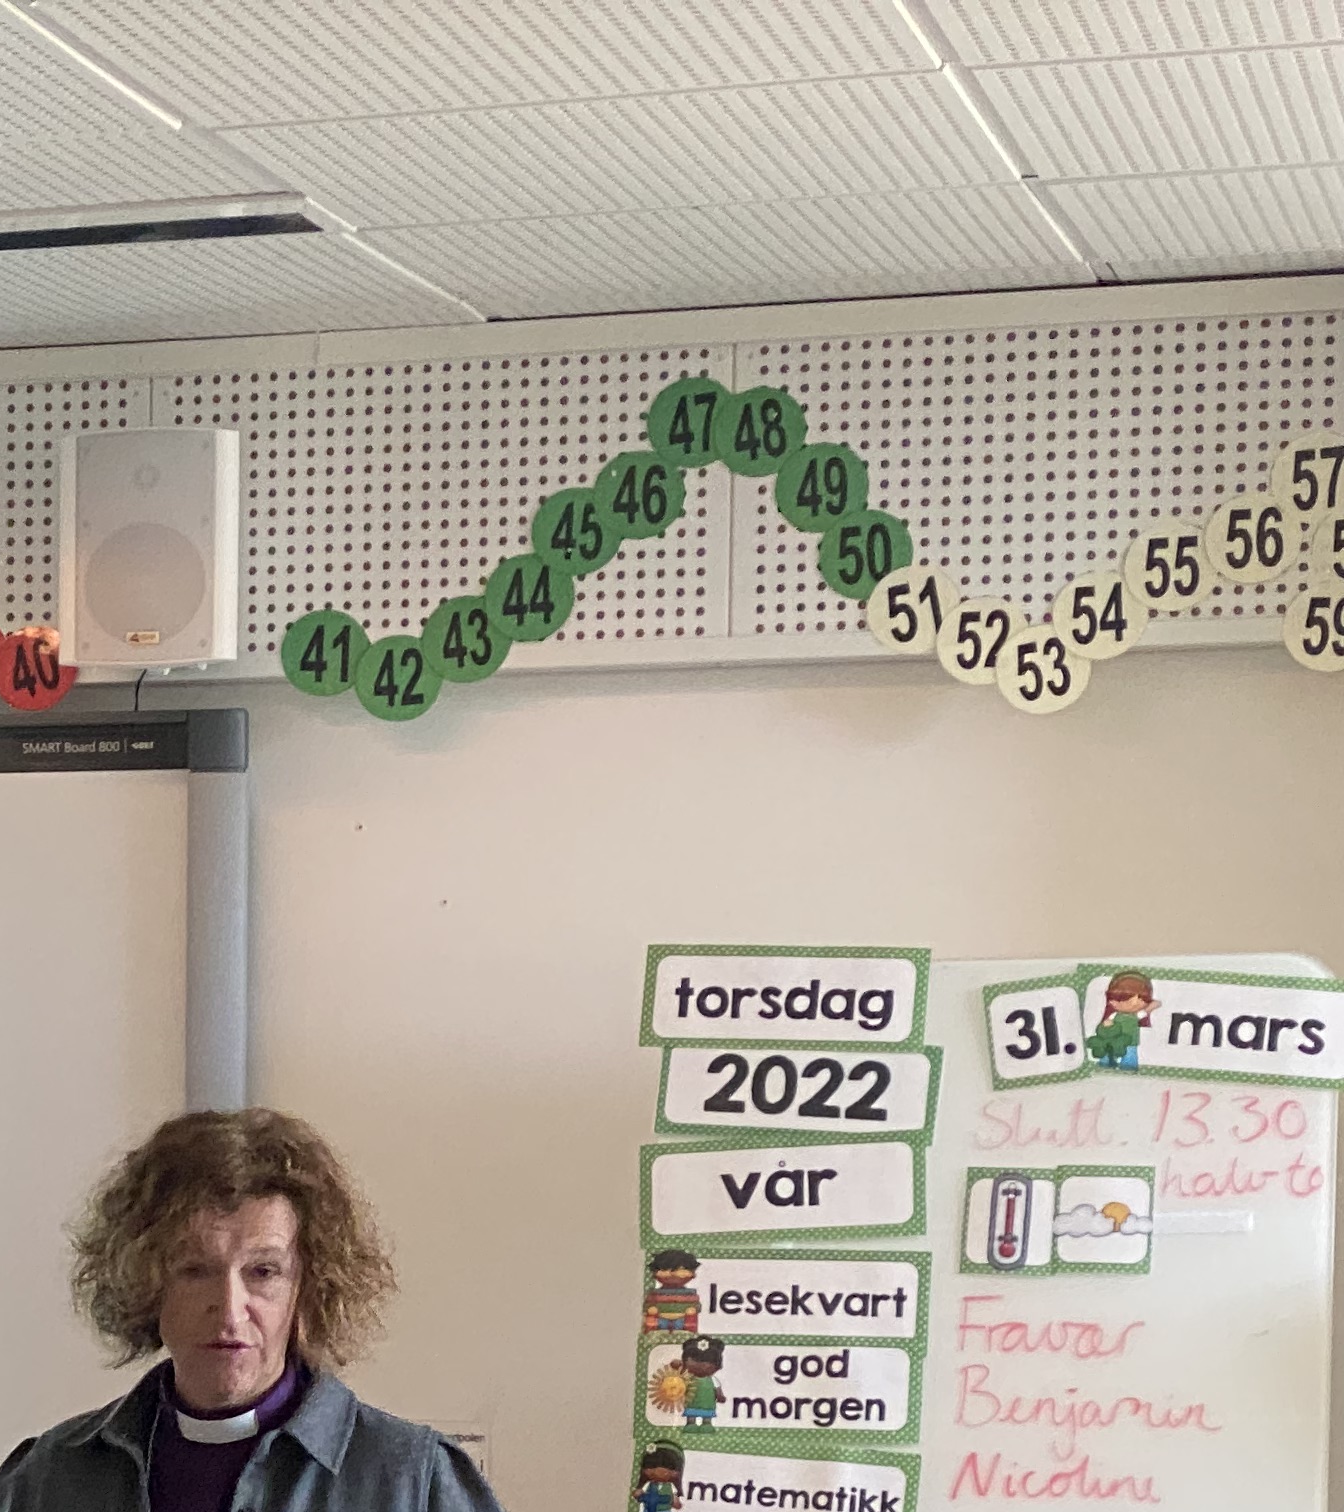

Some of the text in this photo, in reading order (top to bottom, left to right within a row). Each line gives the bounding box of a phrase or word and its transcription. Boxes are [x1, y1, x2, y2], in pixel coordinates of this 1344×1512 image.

[668, 392, 891, 583] 47 48 49 50
[299, 465, 667, 706] 41 42 43 44 45 46
[887, 576, 943, 643] 51
[957, 609, 1010, 670] 52
[1017, 638, 1071, 700] 53
[1072, 582, 1127, 645] 54
[1145, 536, 1199, 598] 55
[1225, 506, 1284, 569] 56
[1293, 445, 1344, 511] 57
[12, 638, 59, 697] 40
[22, 742, 61, 754] SMART
[64, 740, 96, 753] Board
[674, 977, 895, 1032] torsdag
[1167, 1011, 1326, 1056] mars
[703, 1052, 892, 1122] 2022
[720, 1160, 838, 1210] vår
[708, 1284, 908, 1318] lesekvart
[772, 1349, 850, 1386] god
[731, 1394, 886, 1431] morgen
[952, 1364, 1222, 1460] Benjamin
